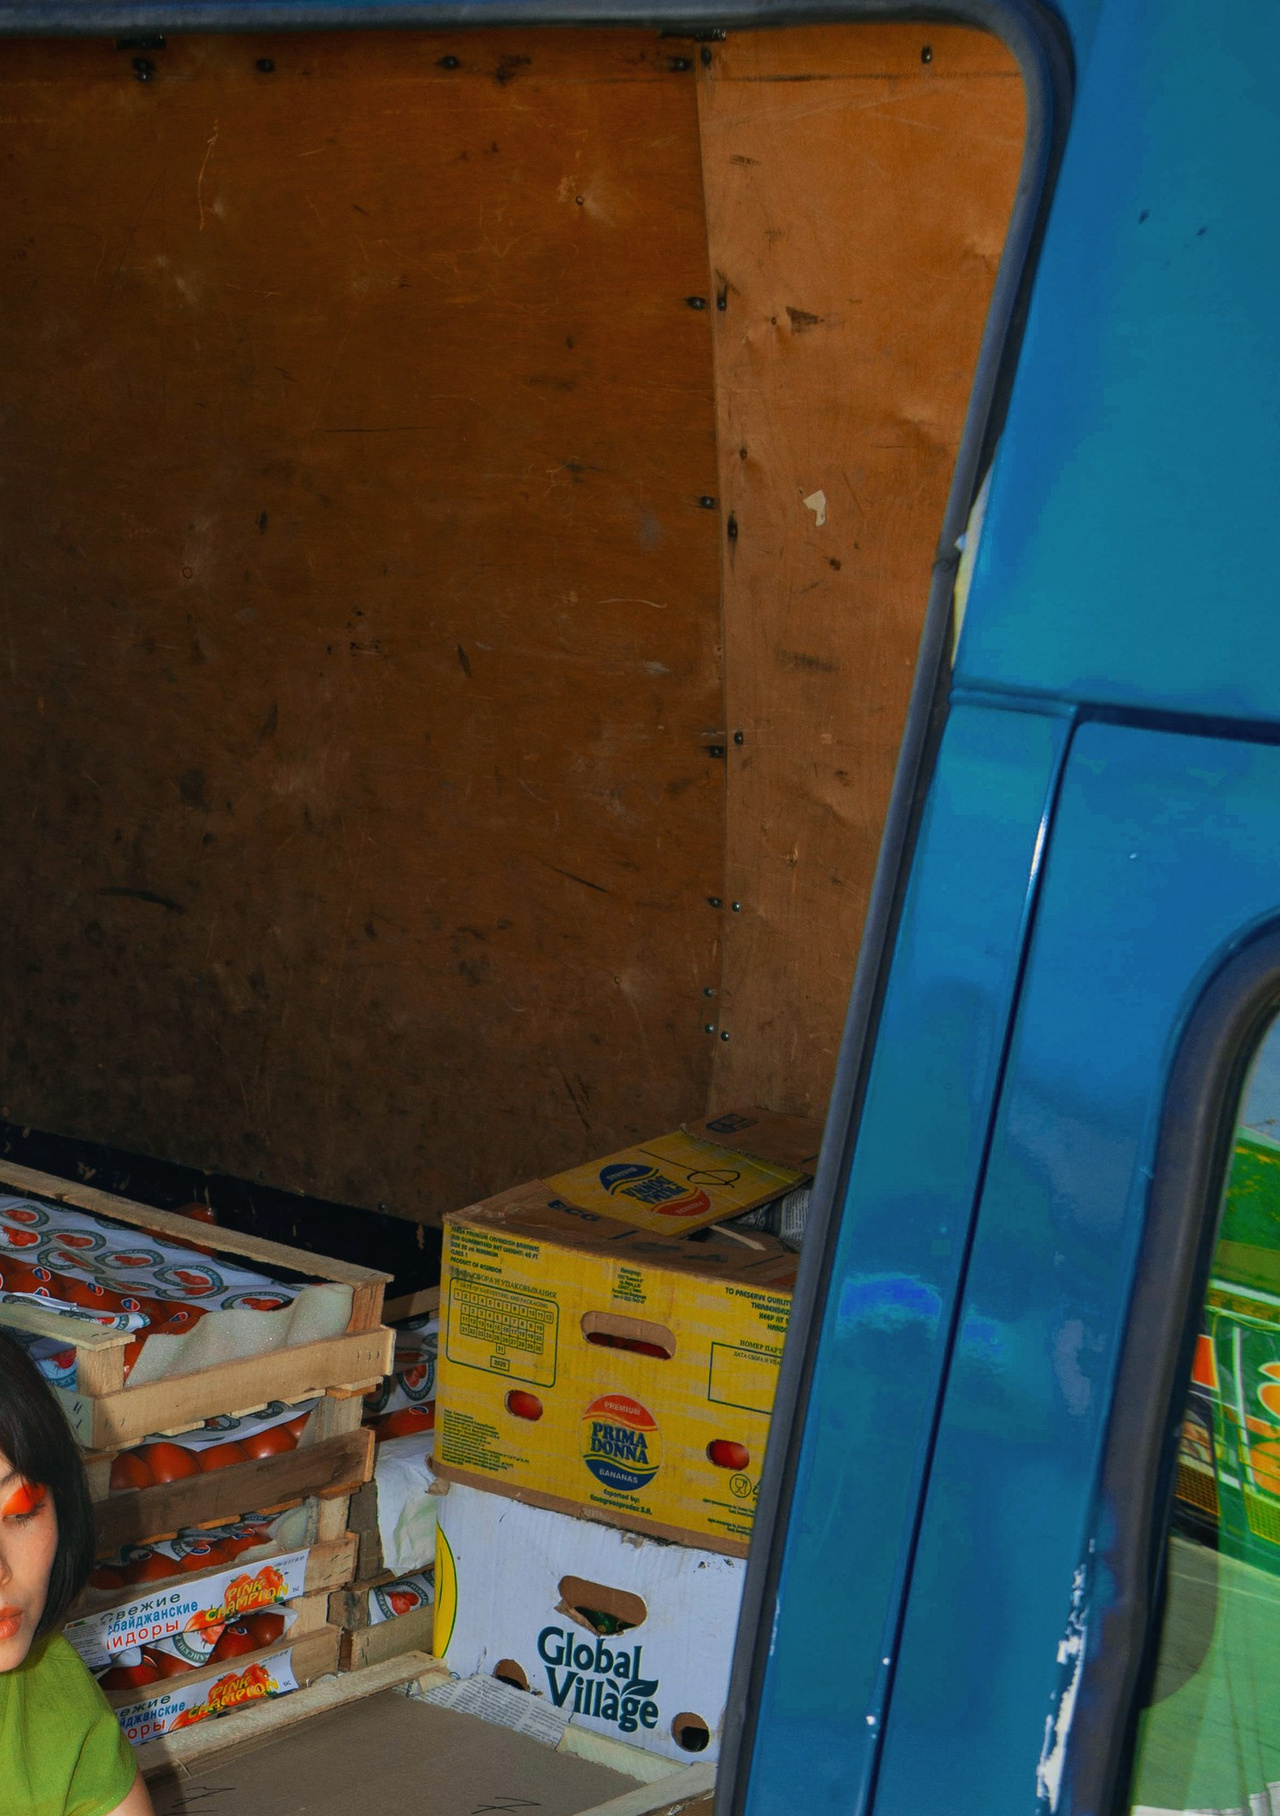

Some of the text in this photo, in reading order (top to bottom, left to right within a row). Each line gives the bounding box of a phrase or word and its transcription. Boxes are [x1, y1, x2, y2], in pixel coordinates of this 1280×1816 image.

[735, 1290, 765, 1301] PRESERVE
[767, 1324, 788, 1333] HAND
[740, 1340, 782, 1354] НОМЕР ПАРТ
[604, 1401, 640, 1415] PREMIUM
[592, 1421, 648, 1449] PRIMA
[591, 1436, 649, 1464] DONNA
[599, 1468, 638, 1484] BANANAS
[227, 1579, 264, 1601] PINK
[106, 1619, 179, 1651] идоры
[537, 1626, 643, 1681] Global
[188, 1678, 279, 1719] CHAMPION
[211, 1678, 248, 1698] PINK
[545, 1666, 659, 1733] Village
[116, 1694, 172, 1718] ежие
